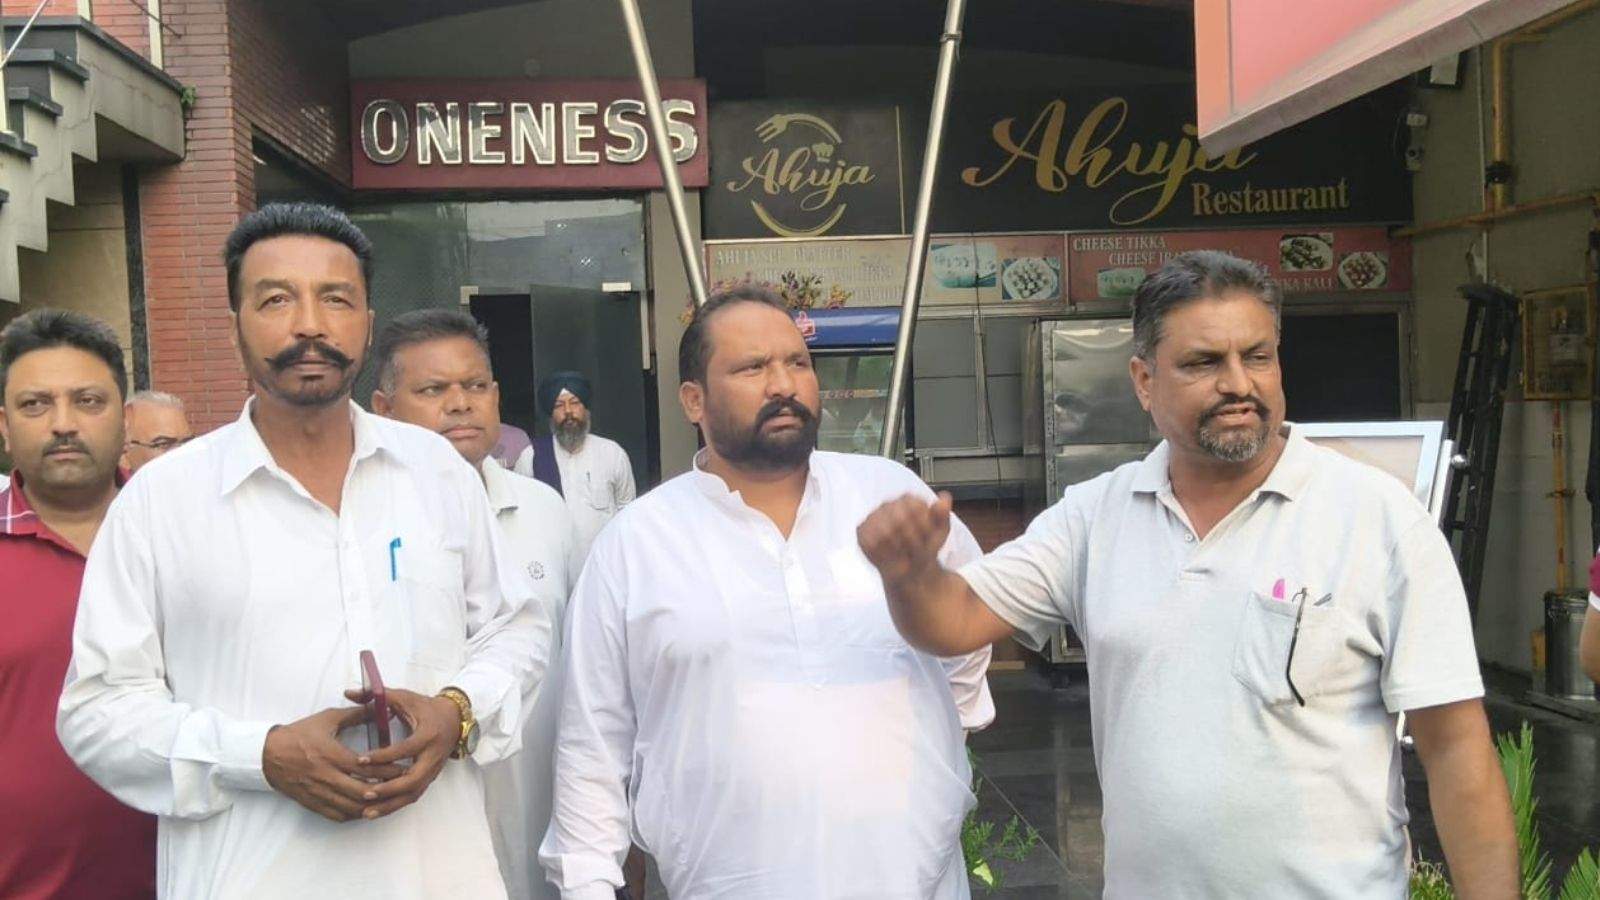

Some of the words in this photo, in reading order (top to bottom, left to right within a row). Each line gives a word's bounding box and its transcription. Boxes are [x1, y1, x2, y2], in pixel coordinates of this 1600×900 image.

[361, 99, 699, 165] ONENESS
[726, 147, 876, 211] Ahuja
[1192, 178, 1350, 215] Restaurant
[1073, 237, 1122, 251] CHEESE
[1126, 236, 1166, 249] TIKKA
[1109, 251, 1154, 265] CHEESE
